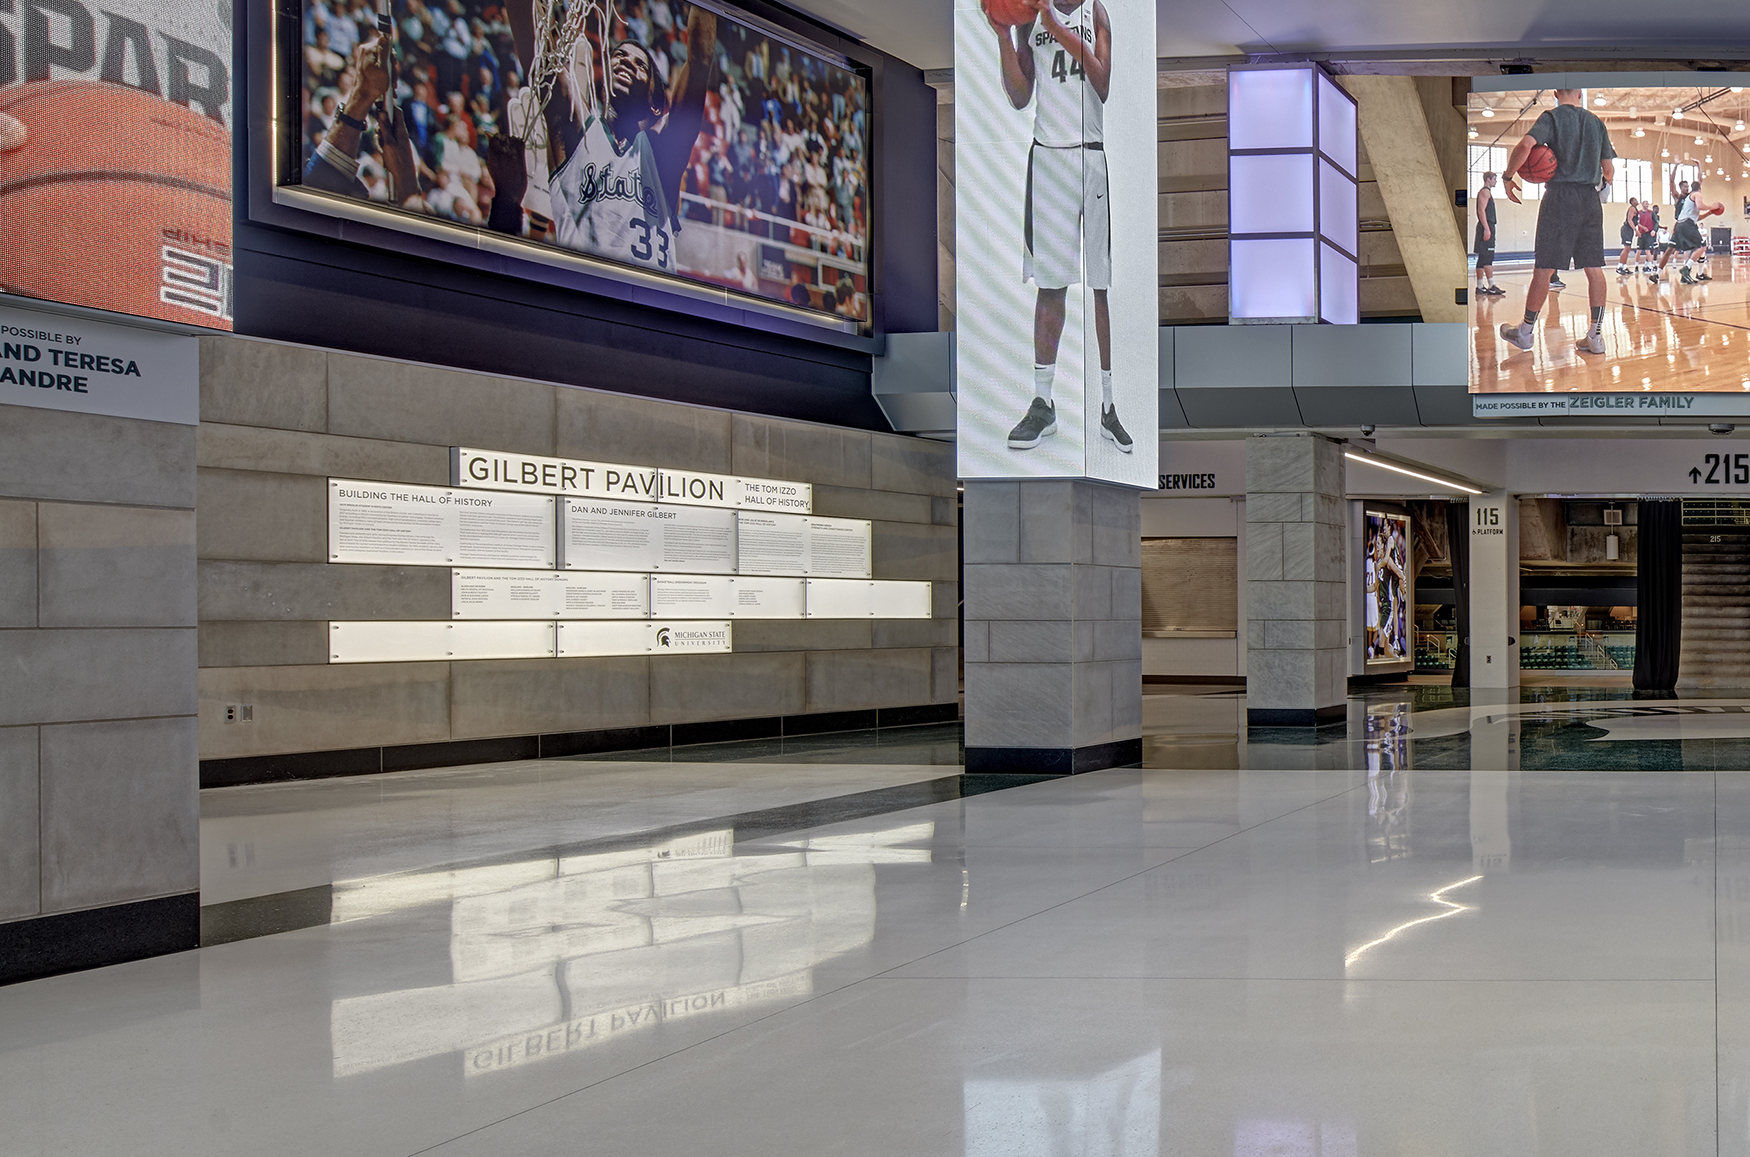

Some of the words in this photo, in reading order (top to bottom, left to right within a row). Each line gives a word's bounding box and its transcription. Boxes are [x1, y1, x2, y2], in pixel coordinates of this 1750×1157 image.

[1035, 25, 1092, 47] SPAANS
[1051, 50, 1085, 83] 44
[578, 162, 659, 217] State
[629, 217, 669, 269] 33
[1, 325, 62, 343] POSSIBLE
[66, 335, 81, 345] BY
[0, 342, 41, 362] ND
[48, 348, 142, 377] TERESA
[0, 367, 88, 393] ANDRE
[1500, 401, 1537, 410] POSSIBLE
[1538, 401, 1549, 409] BY
[1550, 401, 1566, 409] THE
[1568, 396, 1635, 409] ZEIGLER
[1638, 396, 1695, 409] FAMILY
[469, 457, 595, 491] GILBERT
[606, 469, 724, 501] PAVILION
[1705, 454, 1749, 484] 215
[745, 483, 760, 493] THE
[761, 485, 778, 494] TOM
[780, 487, 797, 495] IZZO
[1159, 473, 1216, 490] SERVICES
[339, 489, 387, 500] BUILDING
[390, 493, 409, 502] THE
[412, 494, 436, 504] HALL
[438, 496, 452, 505] OF
[454, 497, 493, 507] HISTORY
[745, 496, 765, 505] HALL
[766, 497, 777, 506] OF
[778, 499, 810, 509] HISTORY
[572, 505, 589, 513] DAN
[590, 507, 607, 515] AND
[609, 508, 646, 518] JENNIFER
[647, 510, 677, 519] GILBERT
[1477, 507, 1499, 526] 115
